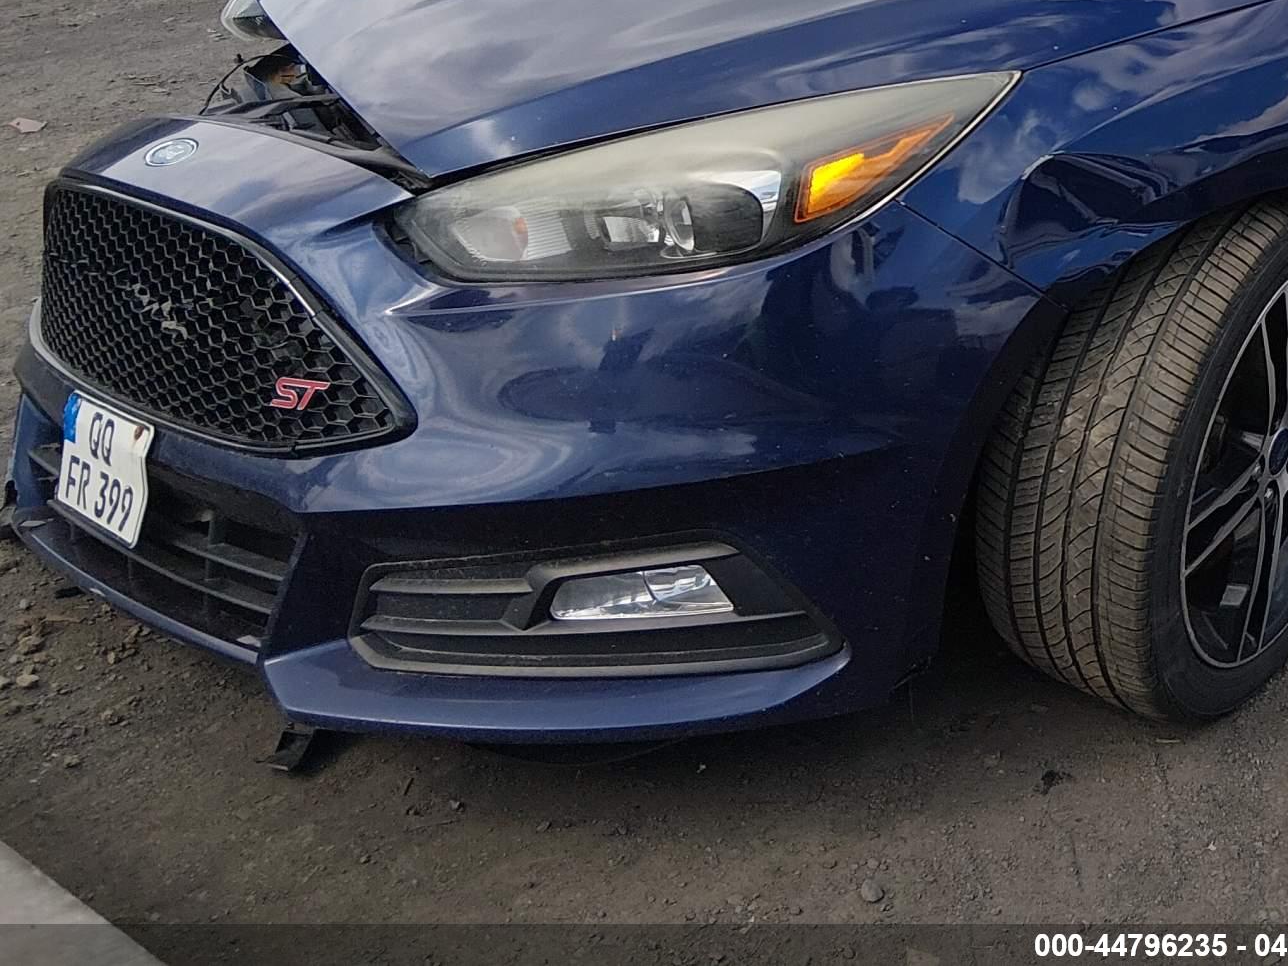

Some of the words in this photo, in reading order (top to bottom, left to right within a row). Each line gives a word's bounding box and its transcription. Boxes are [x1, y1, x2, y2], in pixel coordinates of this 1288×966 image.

[270, 376, 331, 412] ST
[88, 411, 115, 466] QQ
[65, 454, 91, 510] FR
[94, 471, 134, 532] 399
